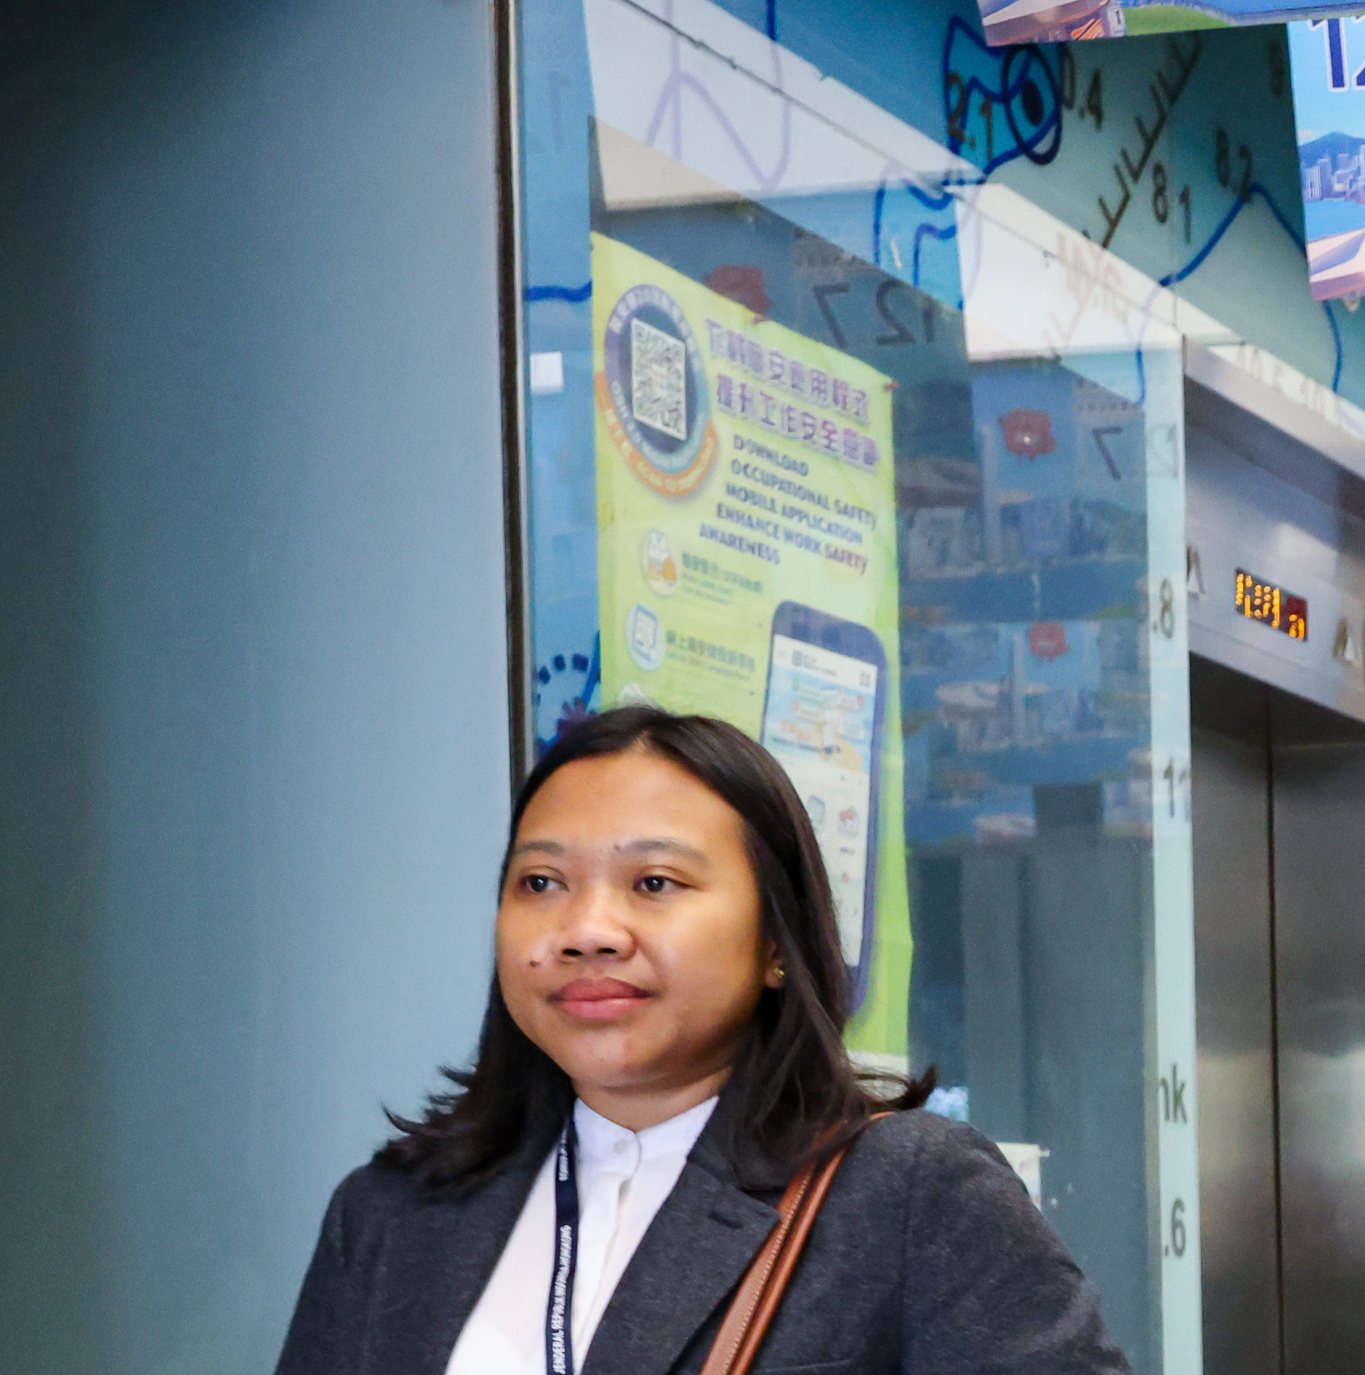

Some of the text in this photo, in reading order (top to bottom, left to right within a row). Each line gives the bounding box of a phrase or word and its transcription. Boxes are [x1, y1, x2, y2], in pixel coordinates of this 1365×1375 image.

[732, 434, 810, 477] DOWNLOAD
[730, 459, 879, 530] OCCUPATIONAL SAFETY
[699, 524, 781, 567] AWARENESS
[716, 504, 781, 541] ENHANCE
[823, 543, 869, 578] SAFETY
